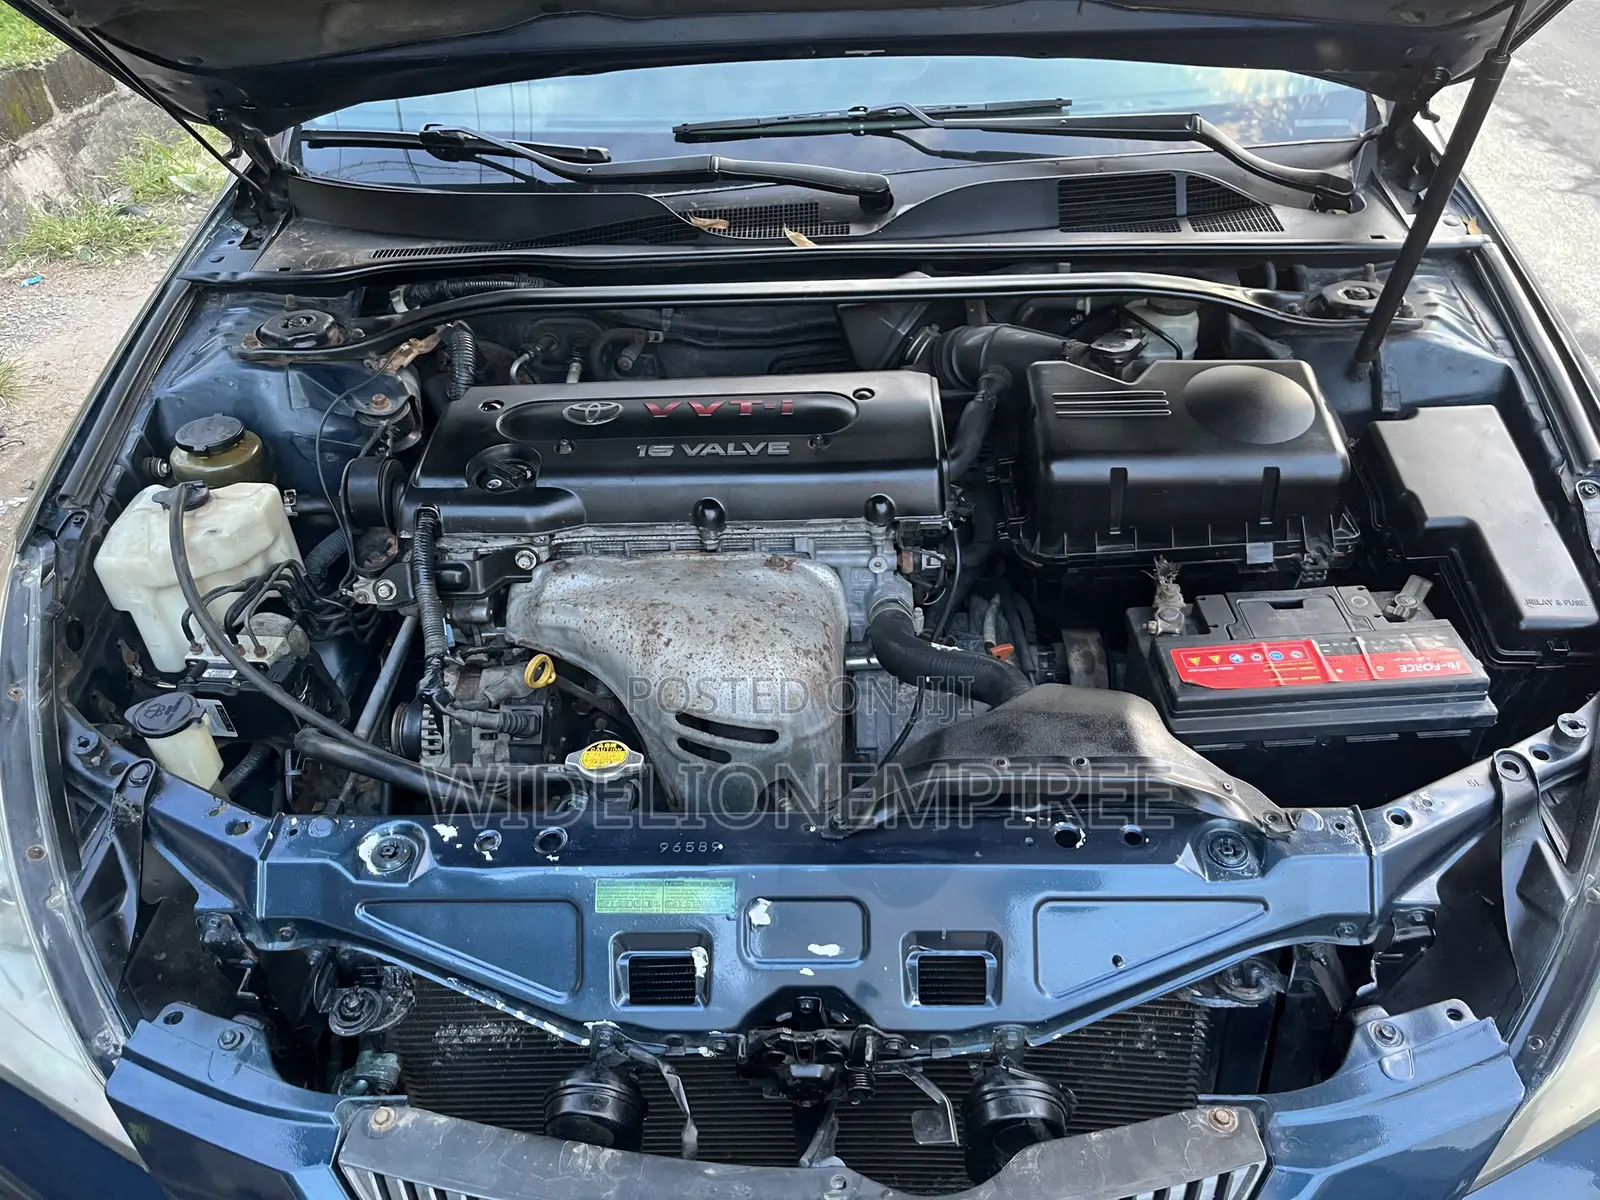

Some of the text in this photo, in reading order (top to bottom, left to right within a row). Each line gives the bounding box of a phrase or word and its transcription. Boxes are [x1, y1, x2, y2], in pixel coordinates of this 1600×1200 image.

[637, 441, 790, 457] 16 VALVE
[659, 841, 722, 853] 96589
